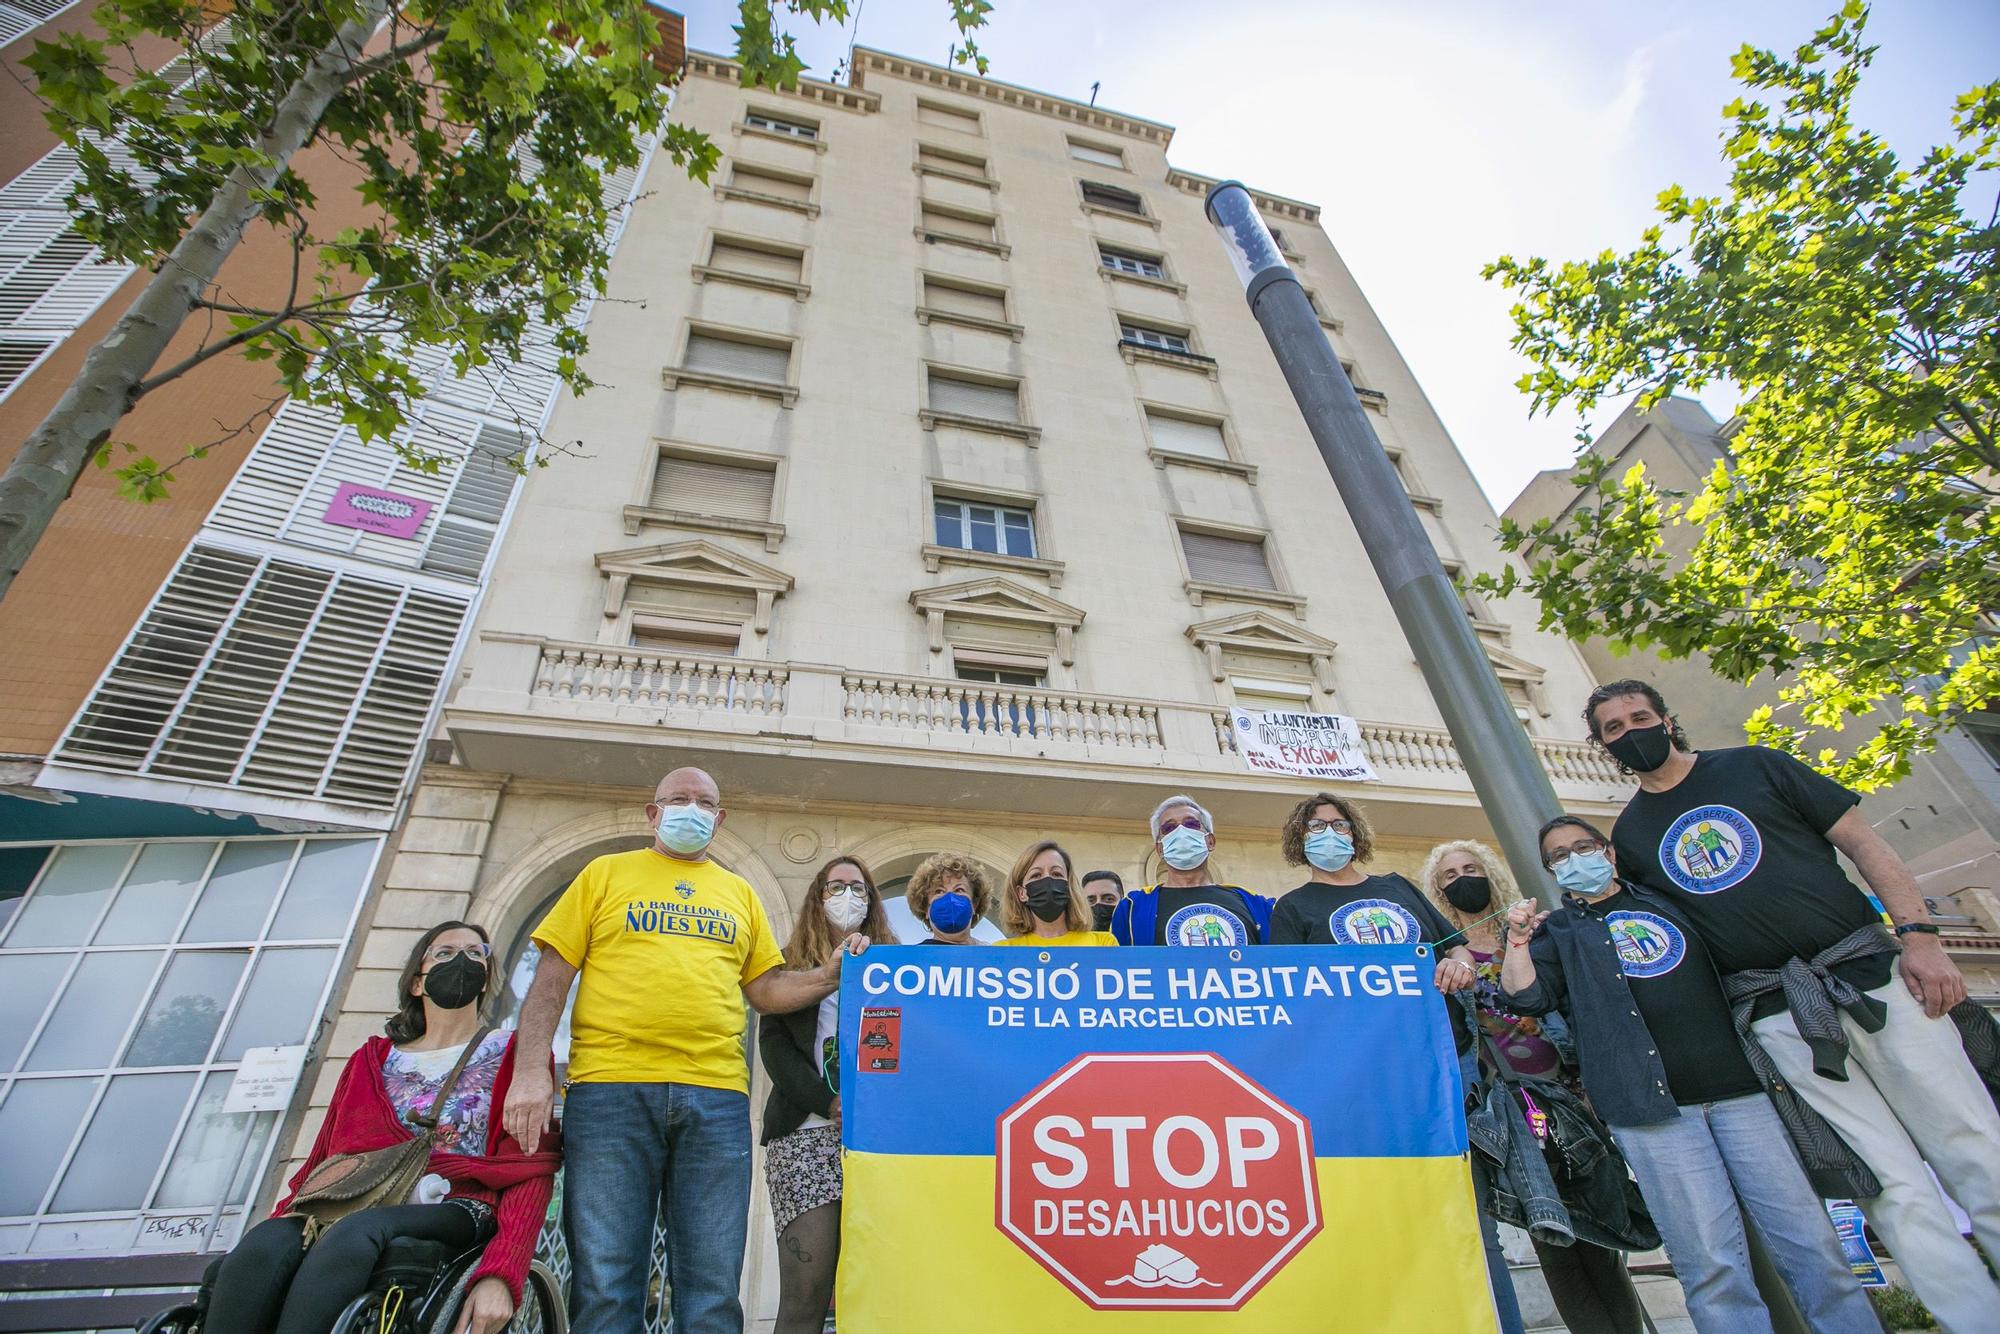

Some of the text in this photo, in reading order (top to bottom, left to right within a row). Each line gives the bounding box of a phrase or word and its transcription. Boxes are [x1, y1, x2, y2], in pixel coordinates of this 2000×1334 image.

[1703, 810, 1745, 830] BERTRAN
[1740, 833, 1755, 866] ORIOLA
[625, 909, 731, 939] NO ES VEN
[628, 901, 645, 910] LA
[862, 962, 1423, 1000] COMISSIÓ DE HABITATGE
[988, 1005, 1293, 1028] DE LA BARCELONETA
[1031, 1115, 1280, 1189] STOP
[1034, 1199, 1290, 1237] DESAHUCIOS
